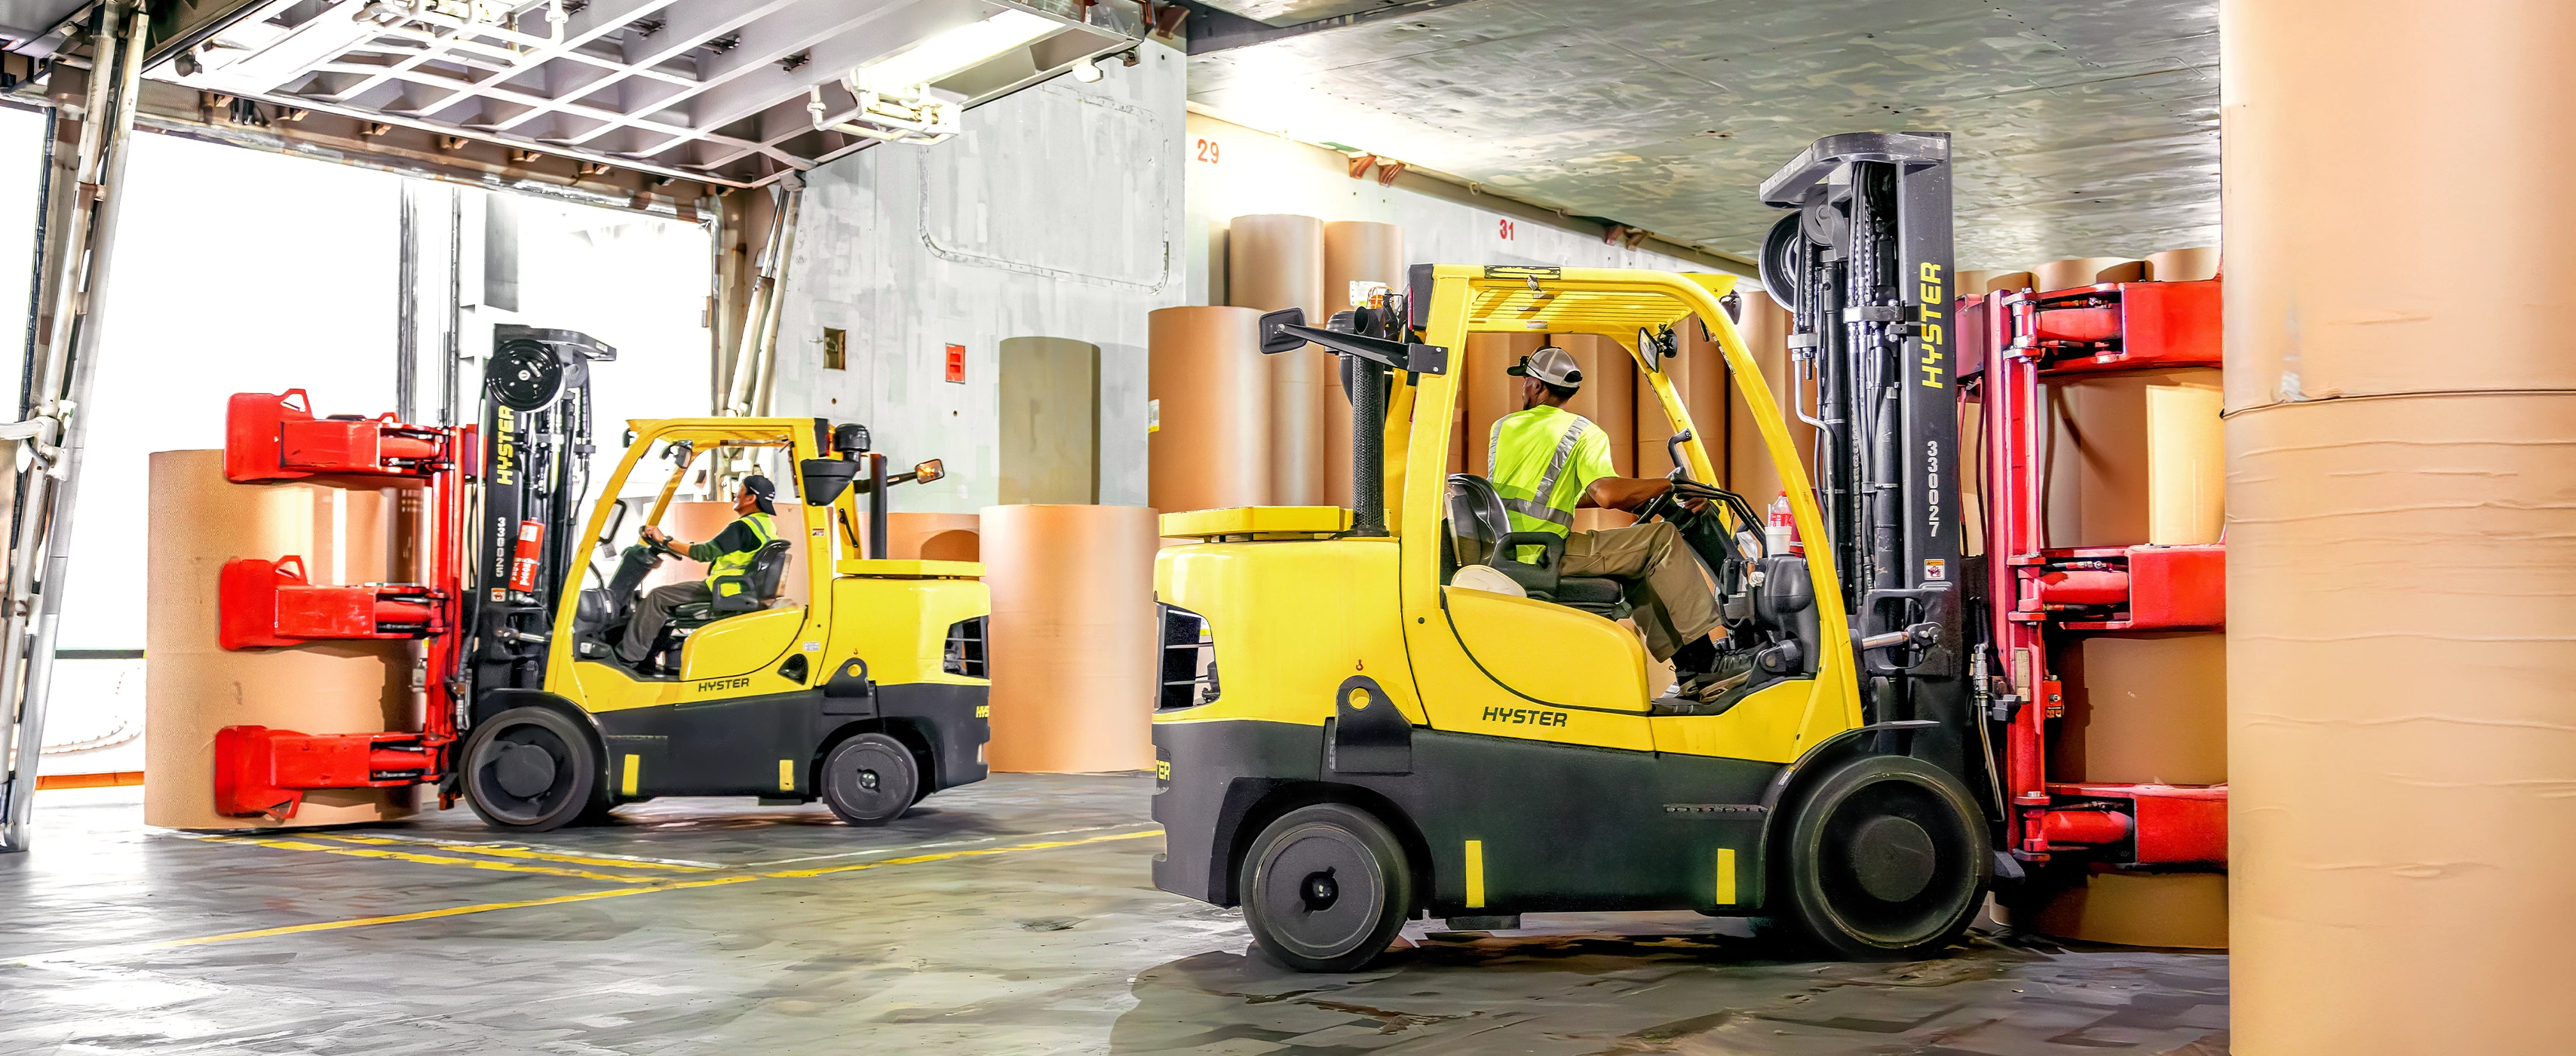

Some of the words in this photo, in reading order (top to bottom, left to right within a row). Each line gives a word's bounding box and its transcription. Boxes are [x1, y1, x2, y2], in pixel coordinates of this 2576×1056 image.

[1198, 139, 1219, 164] 29
[1500, 219, 1513, 241] 31
[1920, 262, 1943, 388] HYSTER
[497, 405, 514, 485] HYSTER
[1927, 441, 1940, 537] 330027
[495, 517, 506, 578] 330025
[698, 678, 750, 692] HYSTER
[1482, 706, 1568, 727] HYSTER
